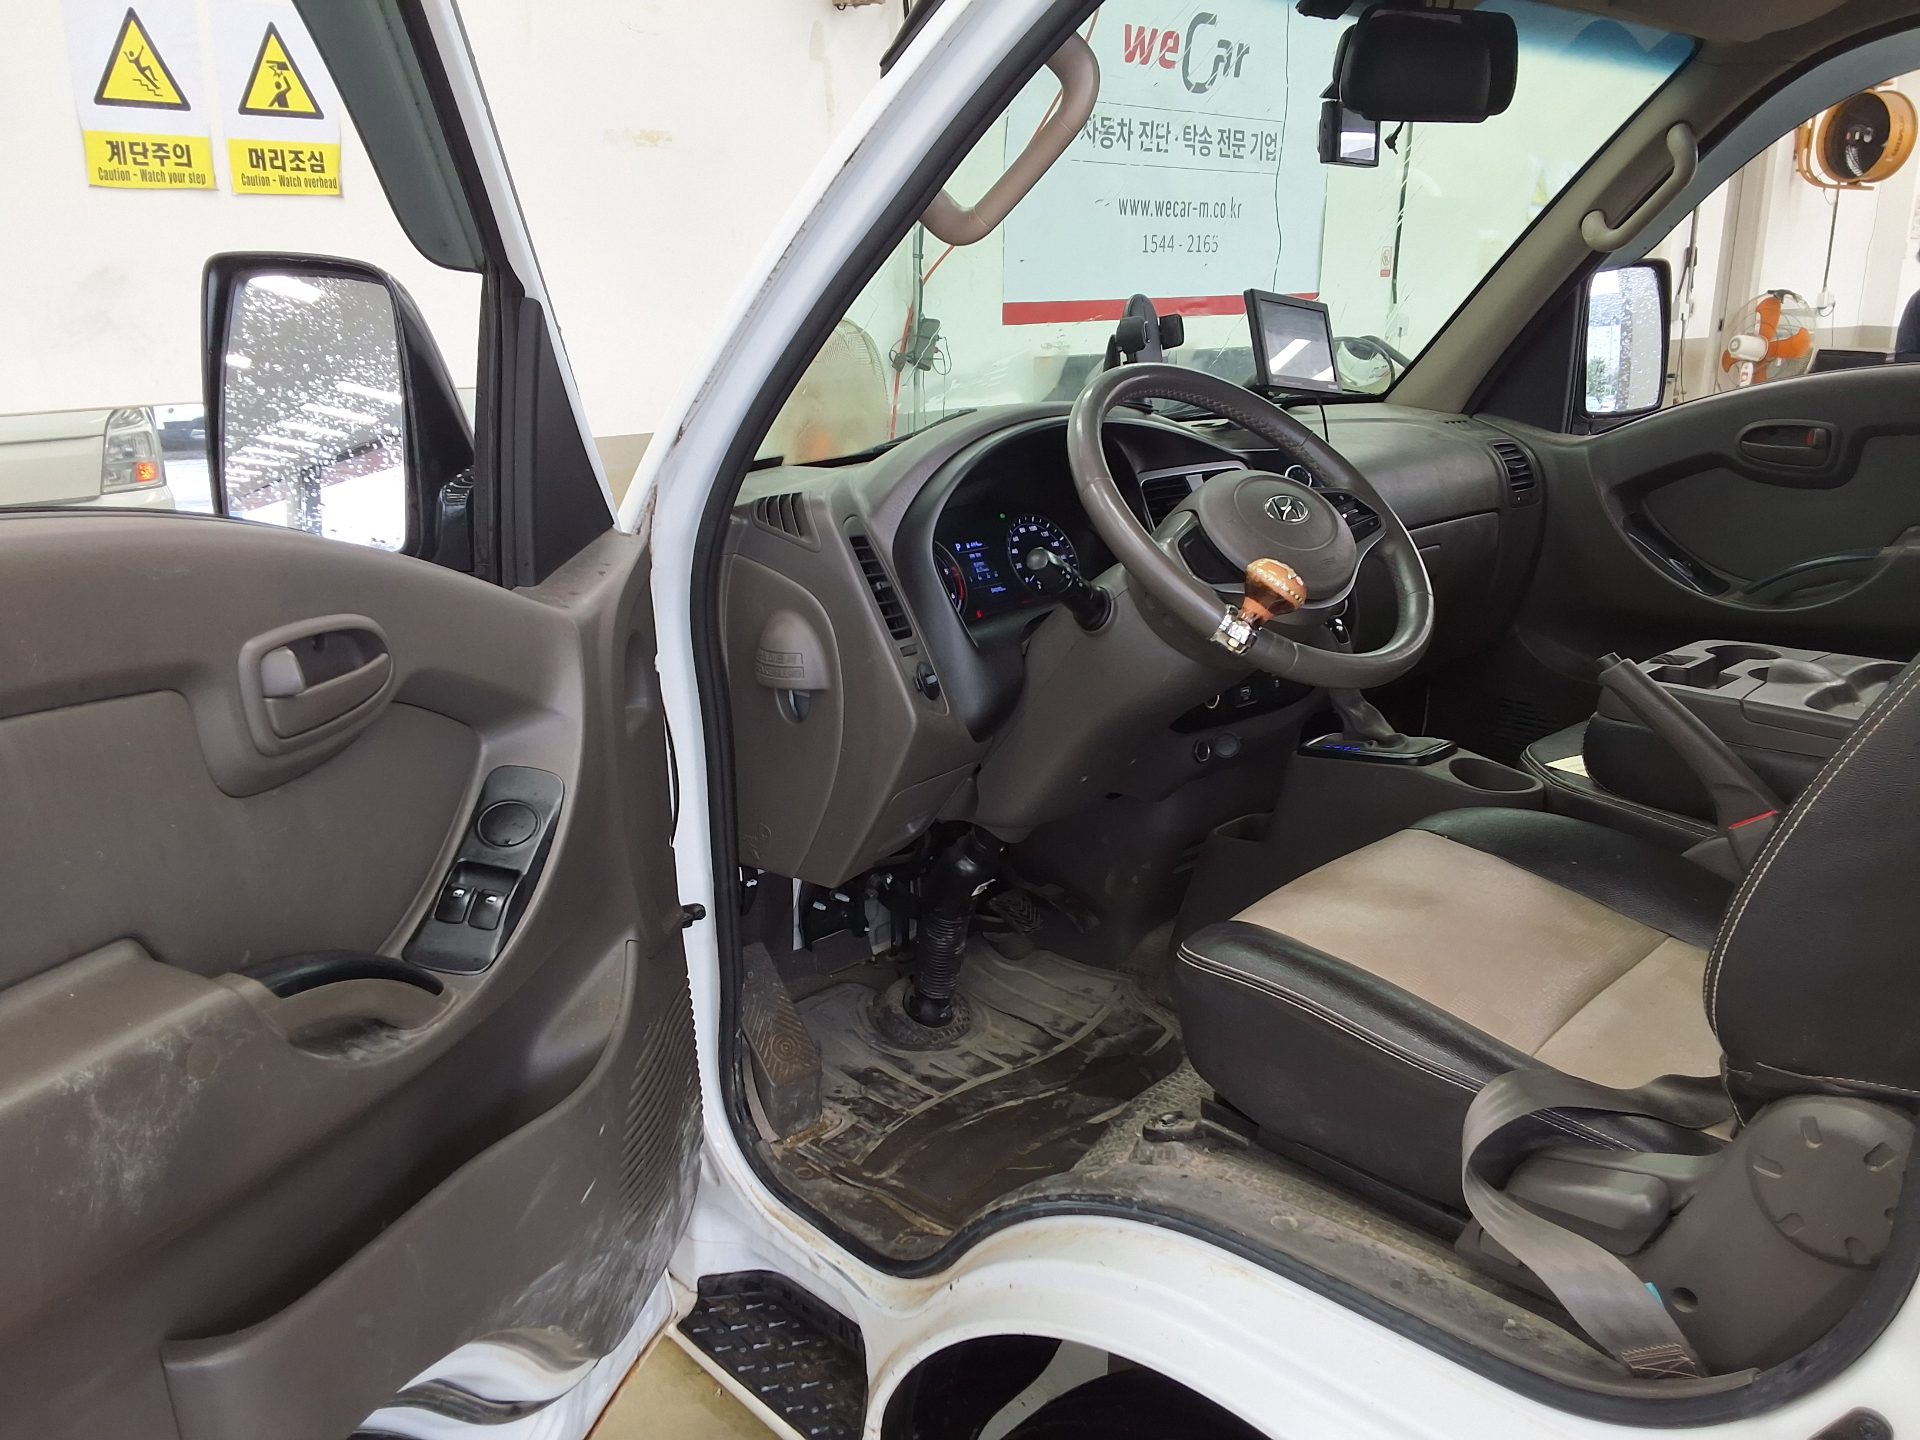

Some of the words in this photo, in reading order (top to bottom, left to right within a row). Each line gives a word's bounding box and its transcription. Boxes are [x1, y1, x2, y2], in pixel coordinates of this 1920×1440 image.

[1124, 12, 1250, 94] weCar
[1080, 114, 1134, 151] 자동차
[1217, 128, 1246, 159] 전문
[1250, 131, 1278, 161] 기업
[105, 140, 193, 168] 계단주의
[247, 147, 326, 174] 머리조심
[98, 167, 131, 181] Caution
[140, 169, 166, 183] Watch
[168, 172, 186, 184] your
[188, 172, 206, 185] step
[241, 173, 270, 187] Caution
[278, 174, 302, 188] Watch
[304, 177, 338, 189] overhead
[1118, 197, 1242, 219] www.wecar-m.co.kr
[955, 543, 961, 552] P
